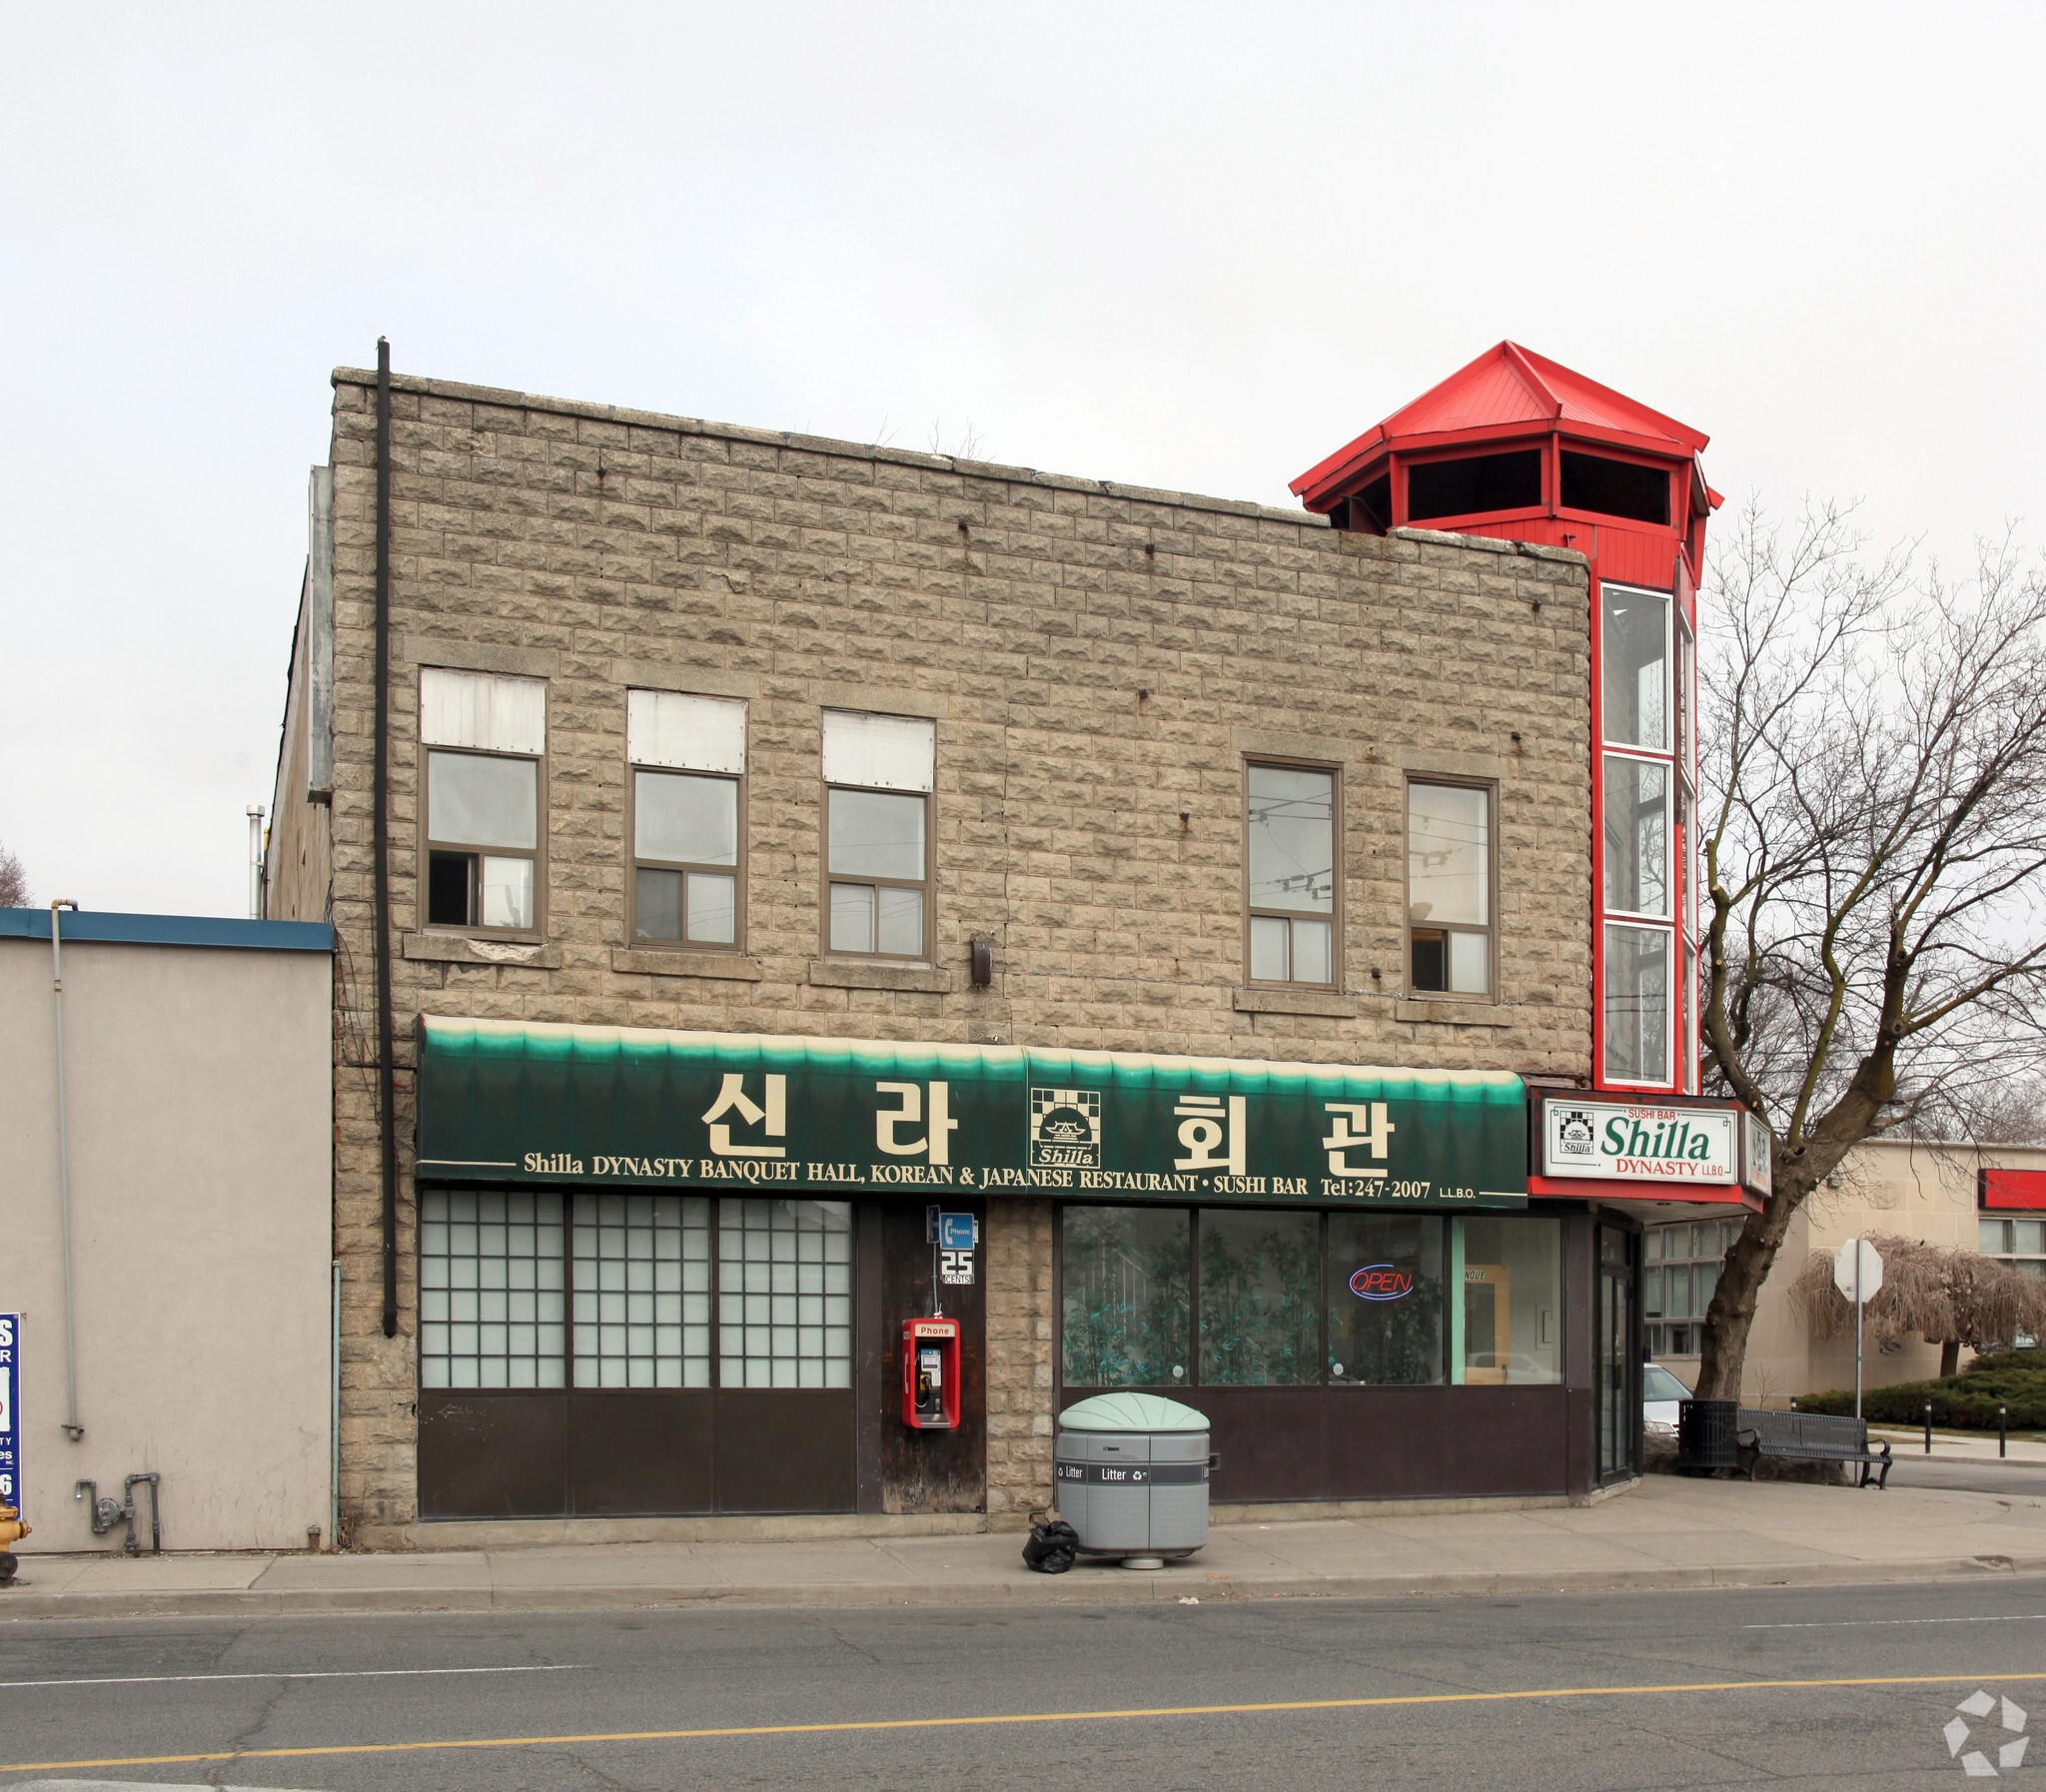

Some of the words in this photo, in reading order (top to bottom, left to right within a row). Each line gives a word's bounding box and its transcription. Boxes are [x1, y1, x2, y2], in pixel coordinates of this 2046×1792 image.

[1627, 1108, 1655, 1120] SUSHI
[1657, 1110, 1675, 1121] BAR
[1600, 1116, 1710, 1161] Shilla
[1564, 1143, 1590, 1153] Shilla
[1038, 1148, 1094, 1165] Shilla
[523, 1152, 584, 1175] Shilla
[592, 1156, 694, 1178] DYNASTY
[699, 1159, 800, 1185] BANQUET
[806, 1163, 865, 1185] HALL,
[870, 1165, 954, 1185] KOREAN
[959, 1167, 975, 1186] &
[979, 1168, 1073, 1190] JAPANESE
[1079, 1170, 1198, 1192] RESTAURANT
[1213, 1176, 1267, 1195] SUSHI
[1272, 1177, 1309, 1196] BAR
[1439, 1188, 1476, 1199] L.L.B.O.
[1615, 1159, 1699, 1177] DYNASTY
[941, 1251, 973, 1276] 25
[945, 1275, 970, 1284] CENTS
[1352, 1272, 1413, 1292] OPEN
[920, 1327, 950, 1336] Phone
[1065, 1465, 1083, 1478] Litter
[1102, 1467, 1127, 1480] Litter
